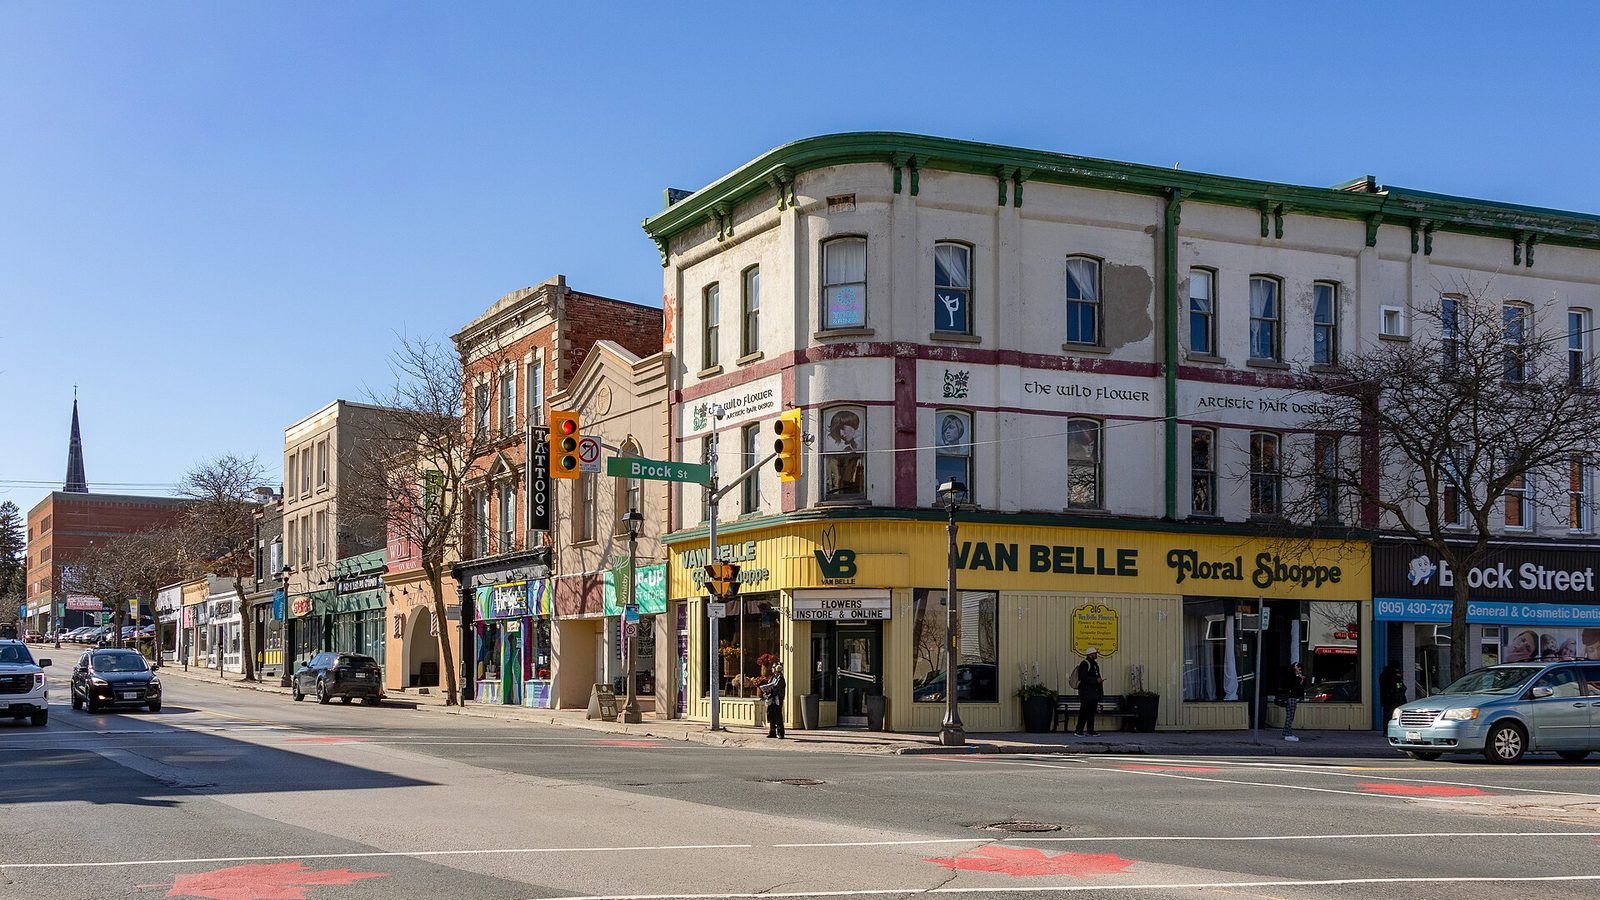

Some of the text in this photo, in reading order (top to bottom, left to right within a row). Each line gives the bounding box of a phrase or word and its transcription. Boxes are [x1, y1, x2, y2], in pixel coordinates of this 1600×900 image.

[534, 429, 546, 517] TATTOOS
[631, 462, 688, 479] Brock St
[681, 548, 708, 569] VAN
[813, 549, 857, 578] VB
[955, 541, 1138, 577] VAN BELLE
[1166, 549, 1341, 588] Floral Shoppe
[621, 573, 629, 604] Whitby
[1439, 560, 1595, 591] Bock Street
[796, 610, 883, 619] INSTORE & ONLINE
[821, 600, 862, 609] FLOWERS
[1378, 602, 1404, 615] (905)
[1468, 605, 1508, 617] General
[1510, 606, 1519, 617] &
[1521, 606, 1570, 619] Cosmetic
